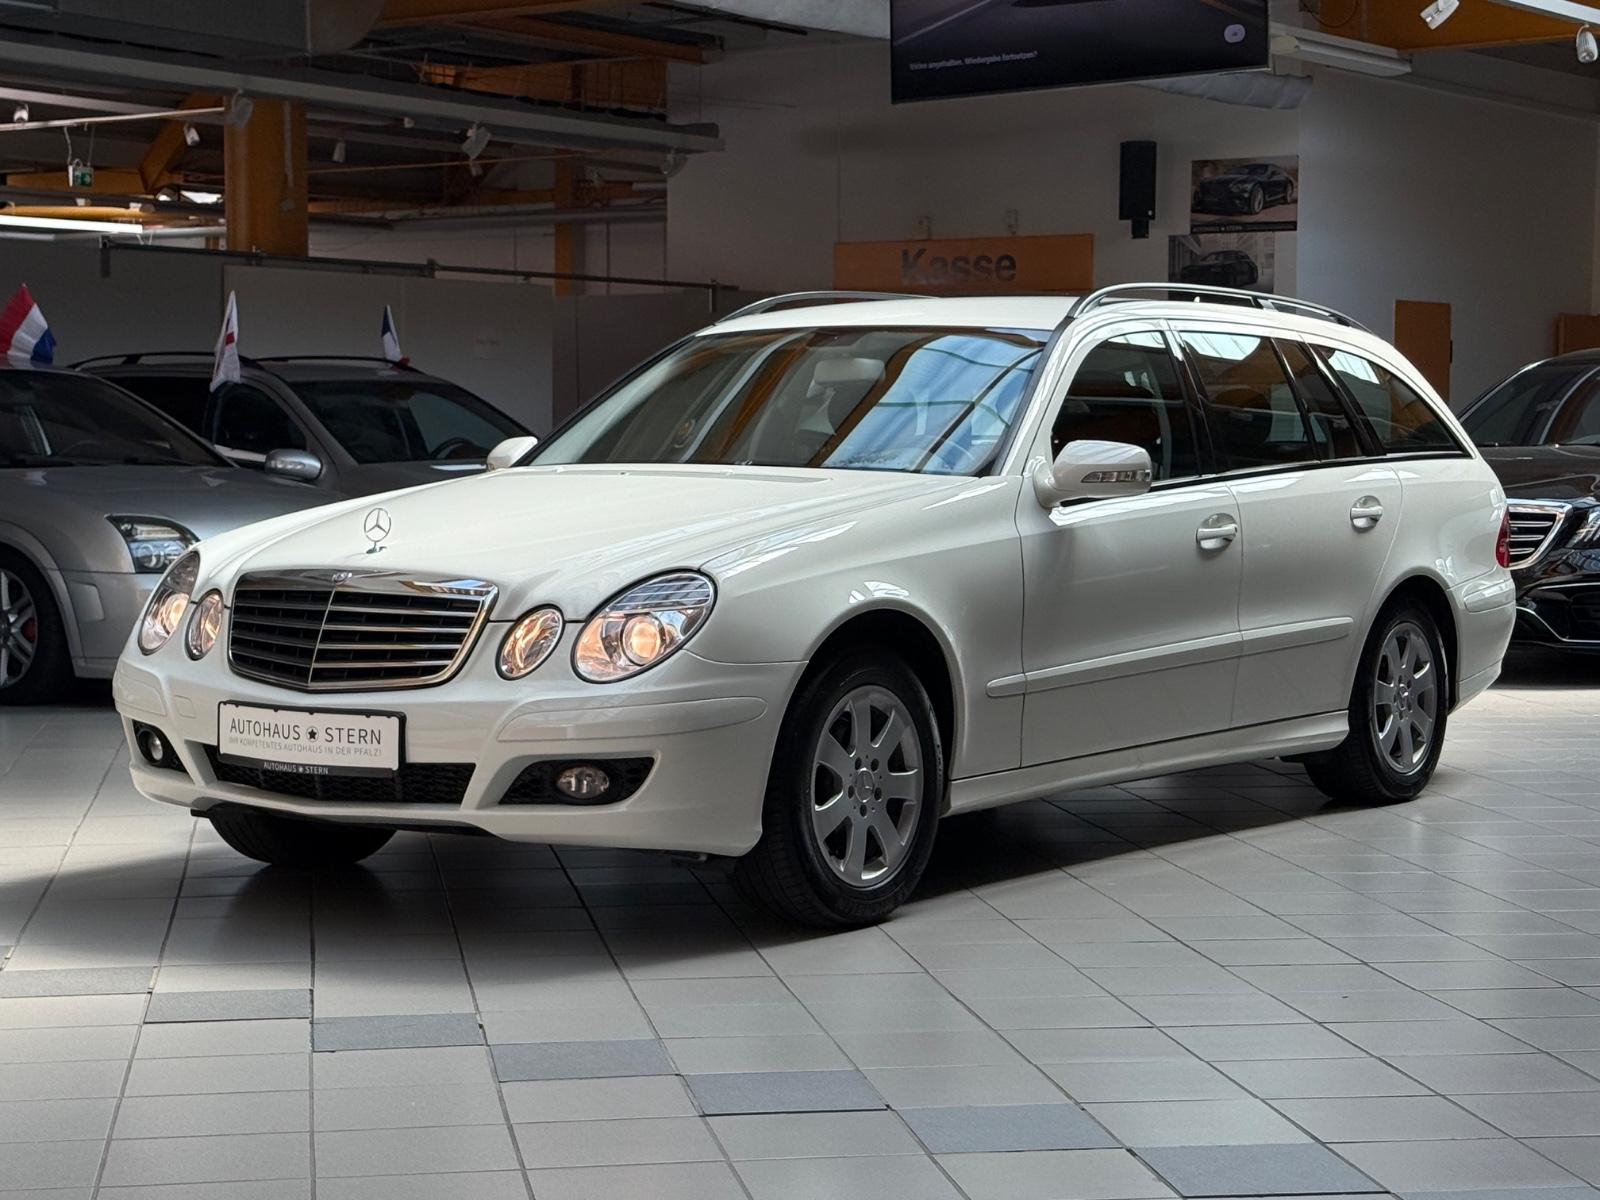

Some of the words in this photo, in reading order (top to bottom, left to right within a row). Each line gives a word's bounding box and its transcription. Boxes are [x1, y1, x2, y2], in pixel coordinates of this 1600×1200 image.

[902, 248, 1017, 285] Kasse
[230, 717, 301, 740] AUTOHAUS
[325, 726, 381, 745] STERN
[284, 743, 322, 754] AUTOHAUS
[325, 746, 333, 754] IN
[336, 746, 352, 756] DER
[263, 761, 297, 773] AUTOHAUS
[305, 765, 329, 775] STERN
